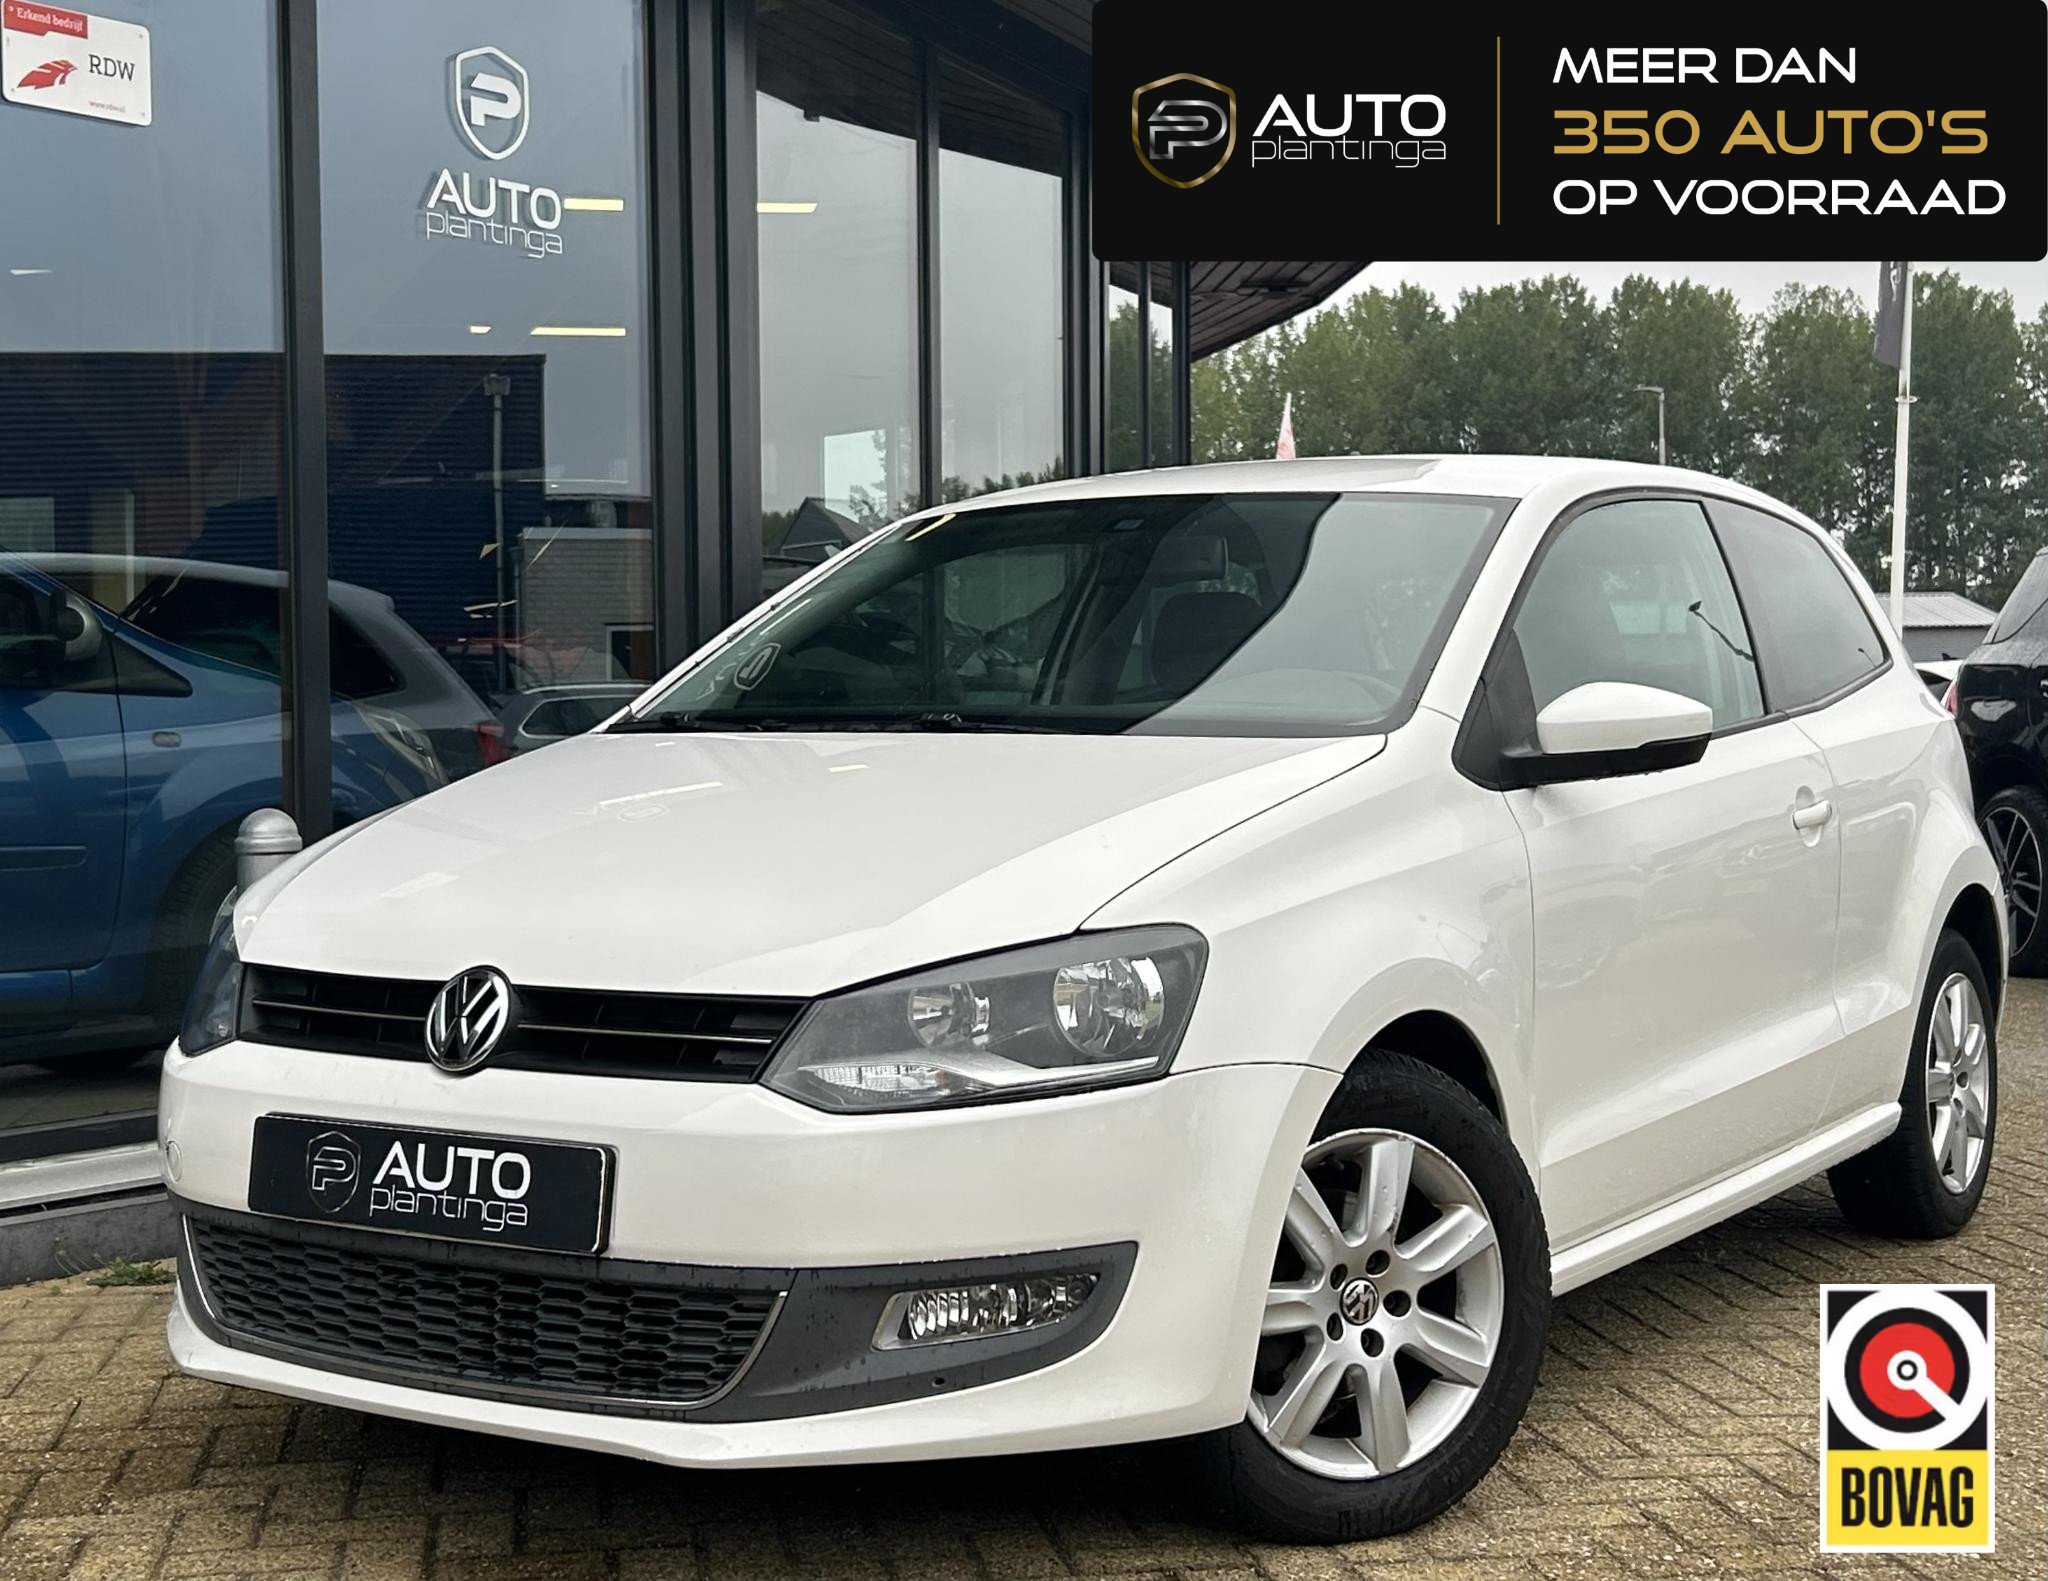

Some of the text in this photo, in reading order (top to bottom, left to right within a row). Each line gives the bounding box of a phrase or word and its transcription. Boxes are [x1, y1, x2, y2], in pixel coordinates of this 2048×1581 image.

[16, 7, 51, 24] Erkend
[88, 54, 136, 81] RDW
[427, 168, 562, 230] AUTO
[426, 211, 563, 258] plantinga
[372, 1140, 532, 1200] AUTO
[369, 1184, 529, 1231] plantinga
